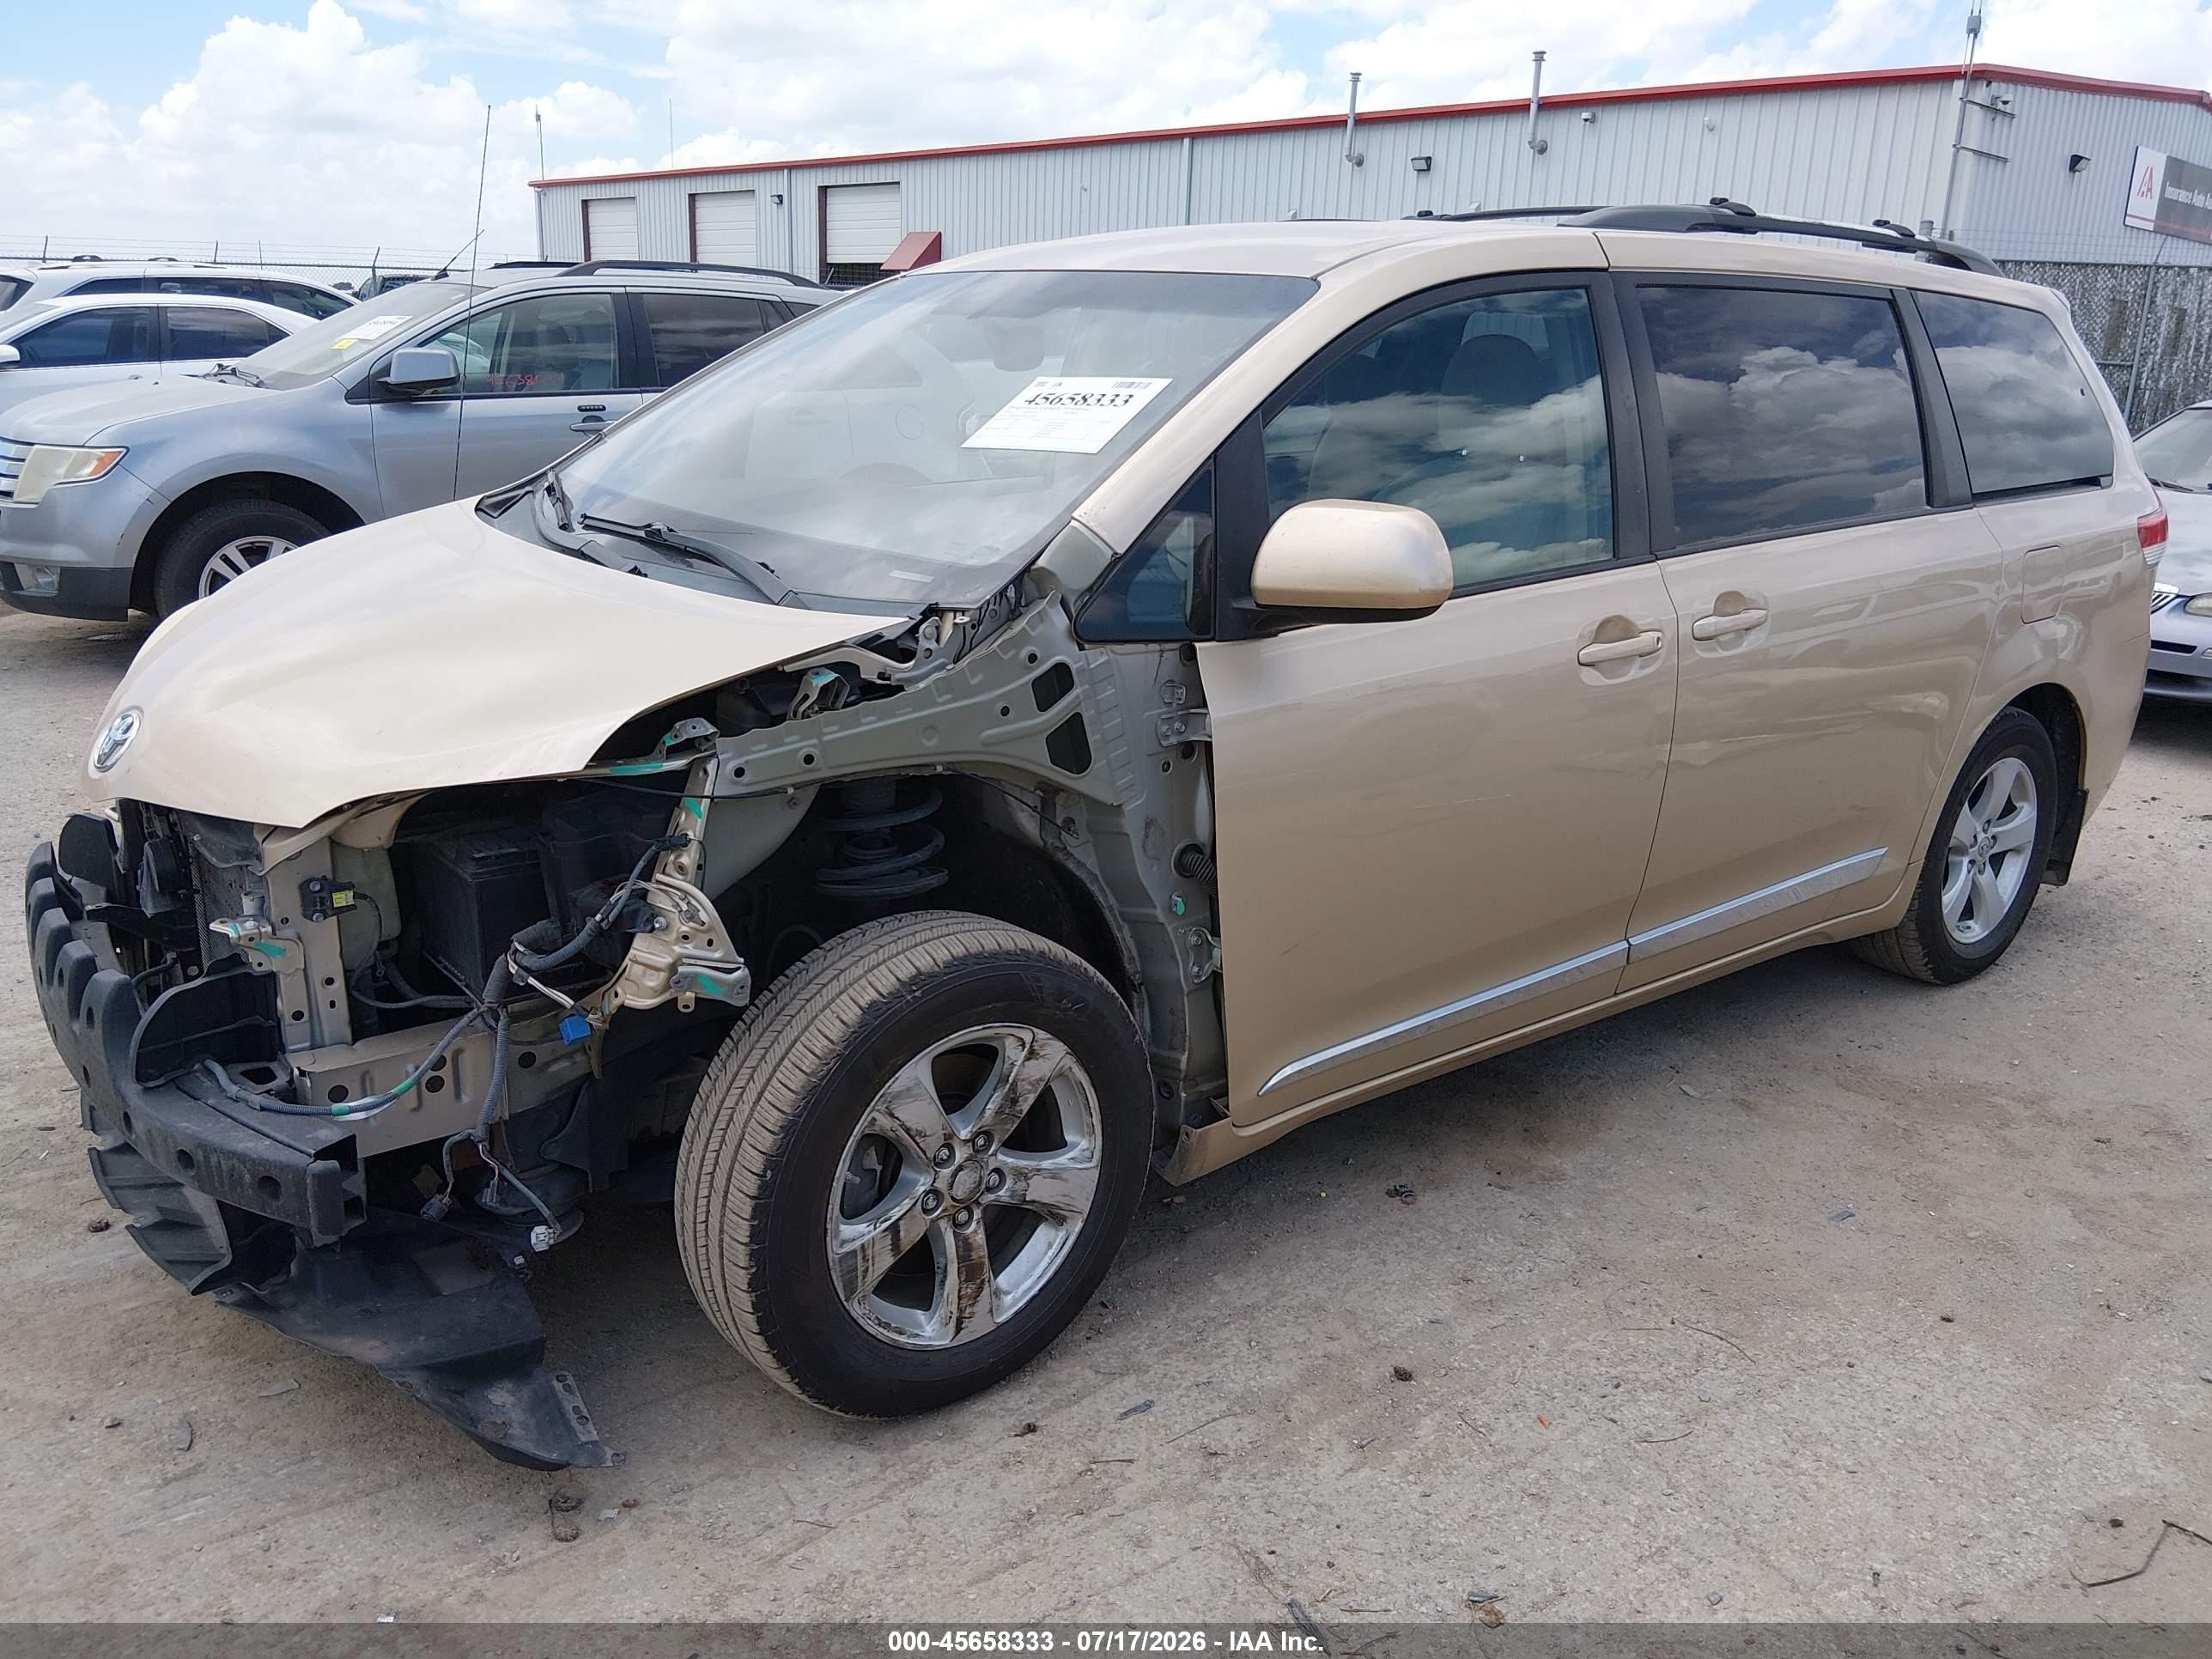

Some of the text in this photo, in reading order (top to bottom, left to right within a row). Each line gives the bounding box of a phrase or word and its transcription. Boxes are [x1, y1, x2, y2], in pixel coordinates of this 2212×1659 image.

[2164, 180, 2193, 204] Insurance
[2191, 188, 2206, 208] Auto
[1024, 392, 1134, 408] 45658333
